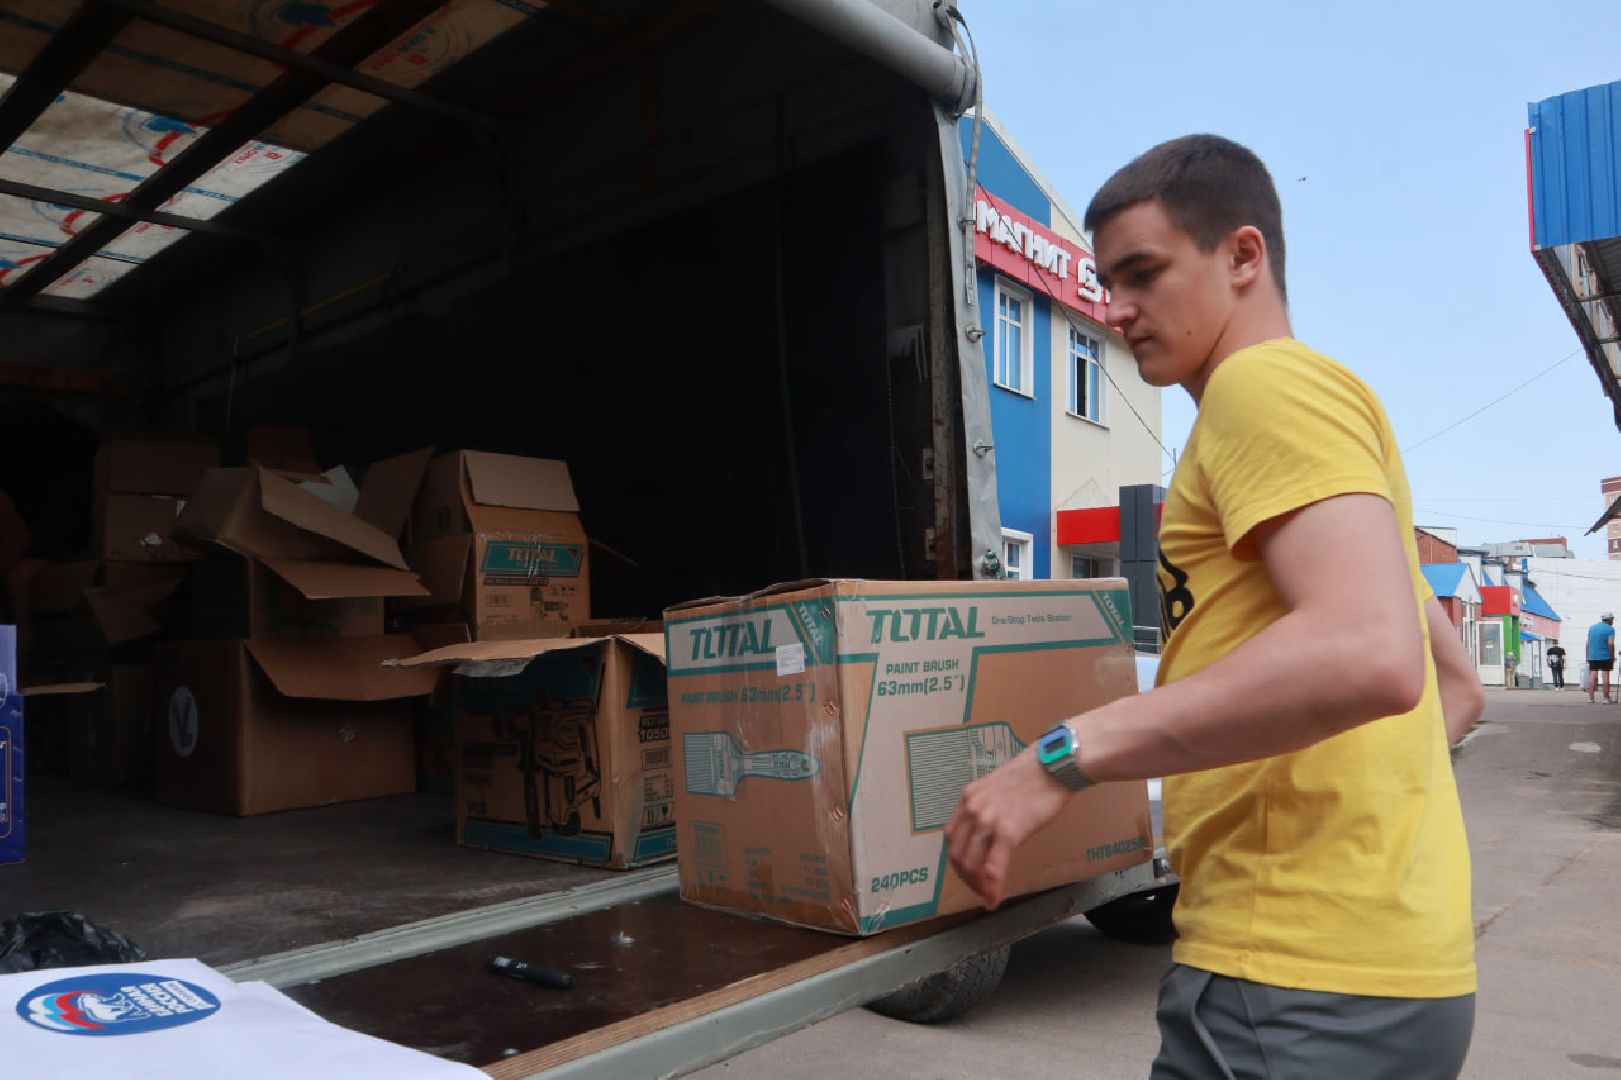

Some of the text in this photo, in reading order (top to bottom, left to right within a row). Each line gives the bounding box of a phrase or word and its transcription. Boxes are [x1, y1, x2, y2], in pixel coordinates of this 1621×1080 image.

[976, 200, 1071, 279] МАГНИТ
[690, 619, 772, 660] TOTAL
[867, 606, 986, 645] TOTAL
[886, 658, 960, 675] PAINT BRUSH
[871, 866, 929, 893] 240PCS
